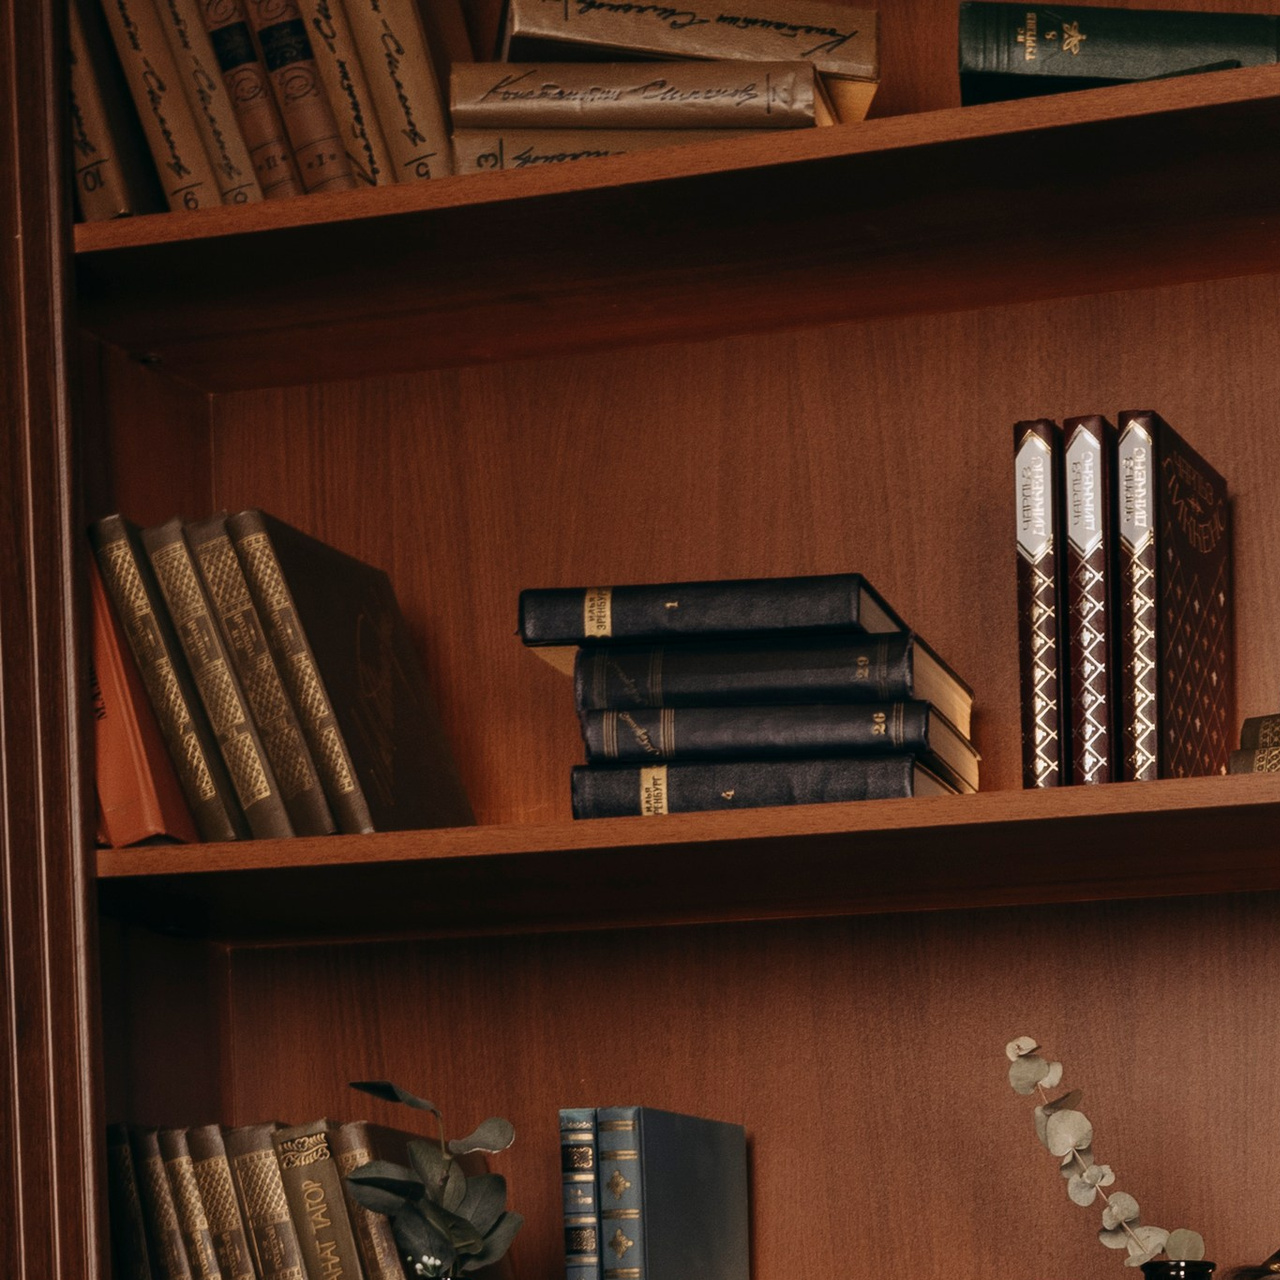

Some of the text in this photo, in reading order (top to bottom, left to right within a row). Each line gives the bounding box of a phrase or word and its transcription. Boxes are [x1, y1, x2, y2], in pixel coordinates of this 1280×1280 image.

[414, 161, 432, 181] 5
[476, 153, 499, 170] 3
[1133, 446, 1148, 529] ДИККЕНС
[854, 656, 871, 681] 29
[871, 711, 888, 736] 26
[652, 775, 662, 814] РЕНБУРГ
[302, 1179, 332, 1236] ТАГОР
